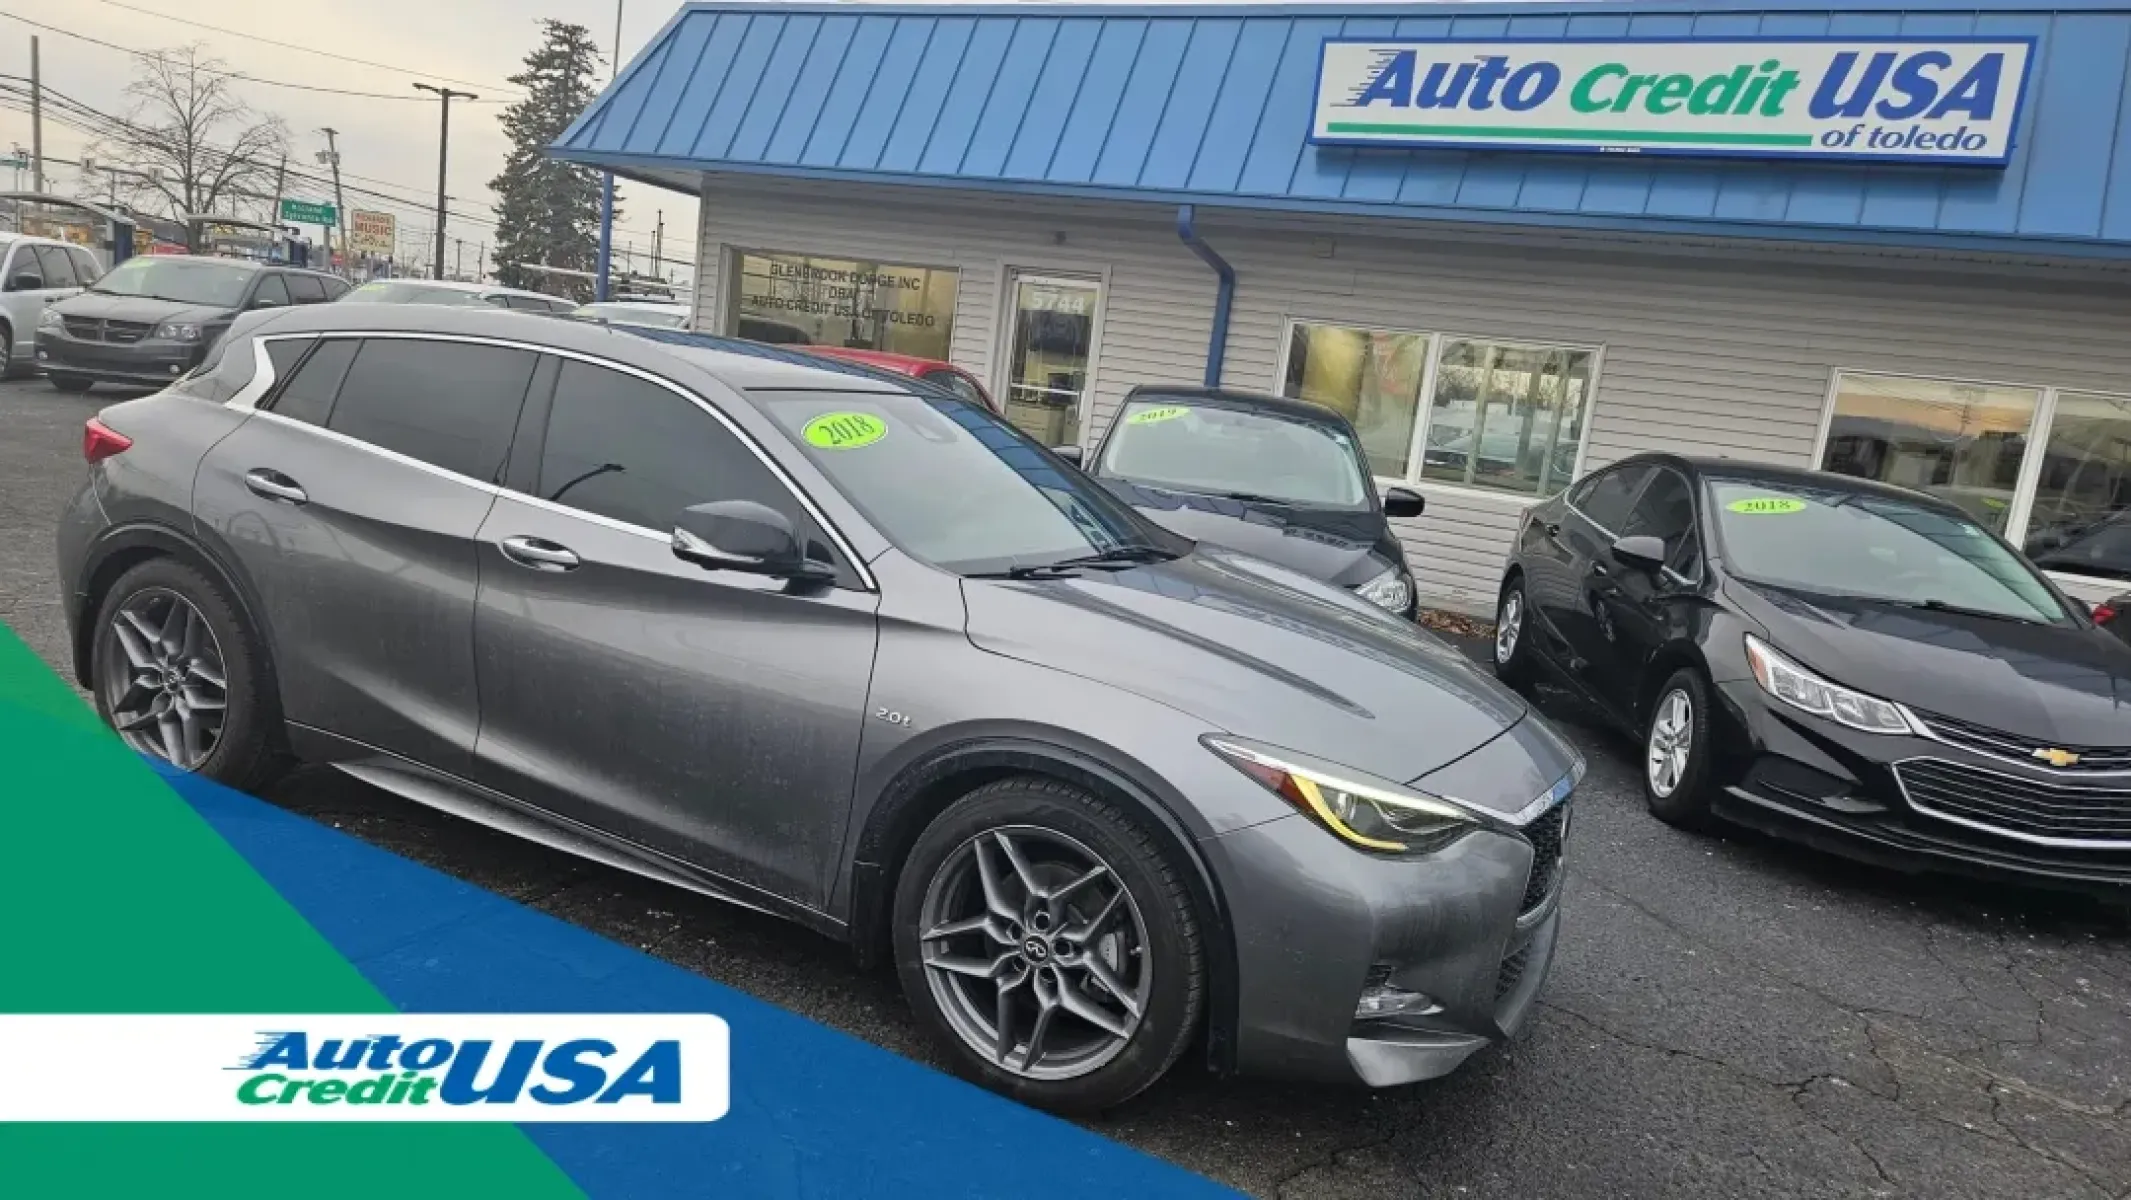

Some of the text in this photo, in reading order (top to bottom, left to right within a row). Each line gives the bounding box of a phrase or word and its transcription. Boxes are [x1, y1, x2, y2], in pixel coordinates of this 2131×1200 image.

[1345, 49, 2005, 121] Auto Credit USA
[1820, 123, 1988, 151] of toledo
[354, 222, 392, 236] MUSIC
[899, 275, 921, 291] INC
[1032, 292, 1085, 314] 5744
[819, 414, 876, 446] 2018
[1743, 500, 1791, 512] 2018
